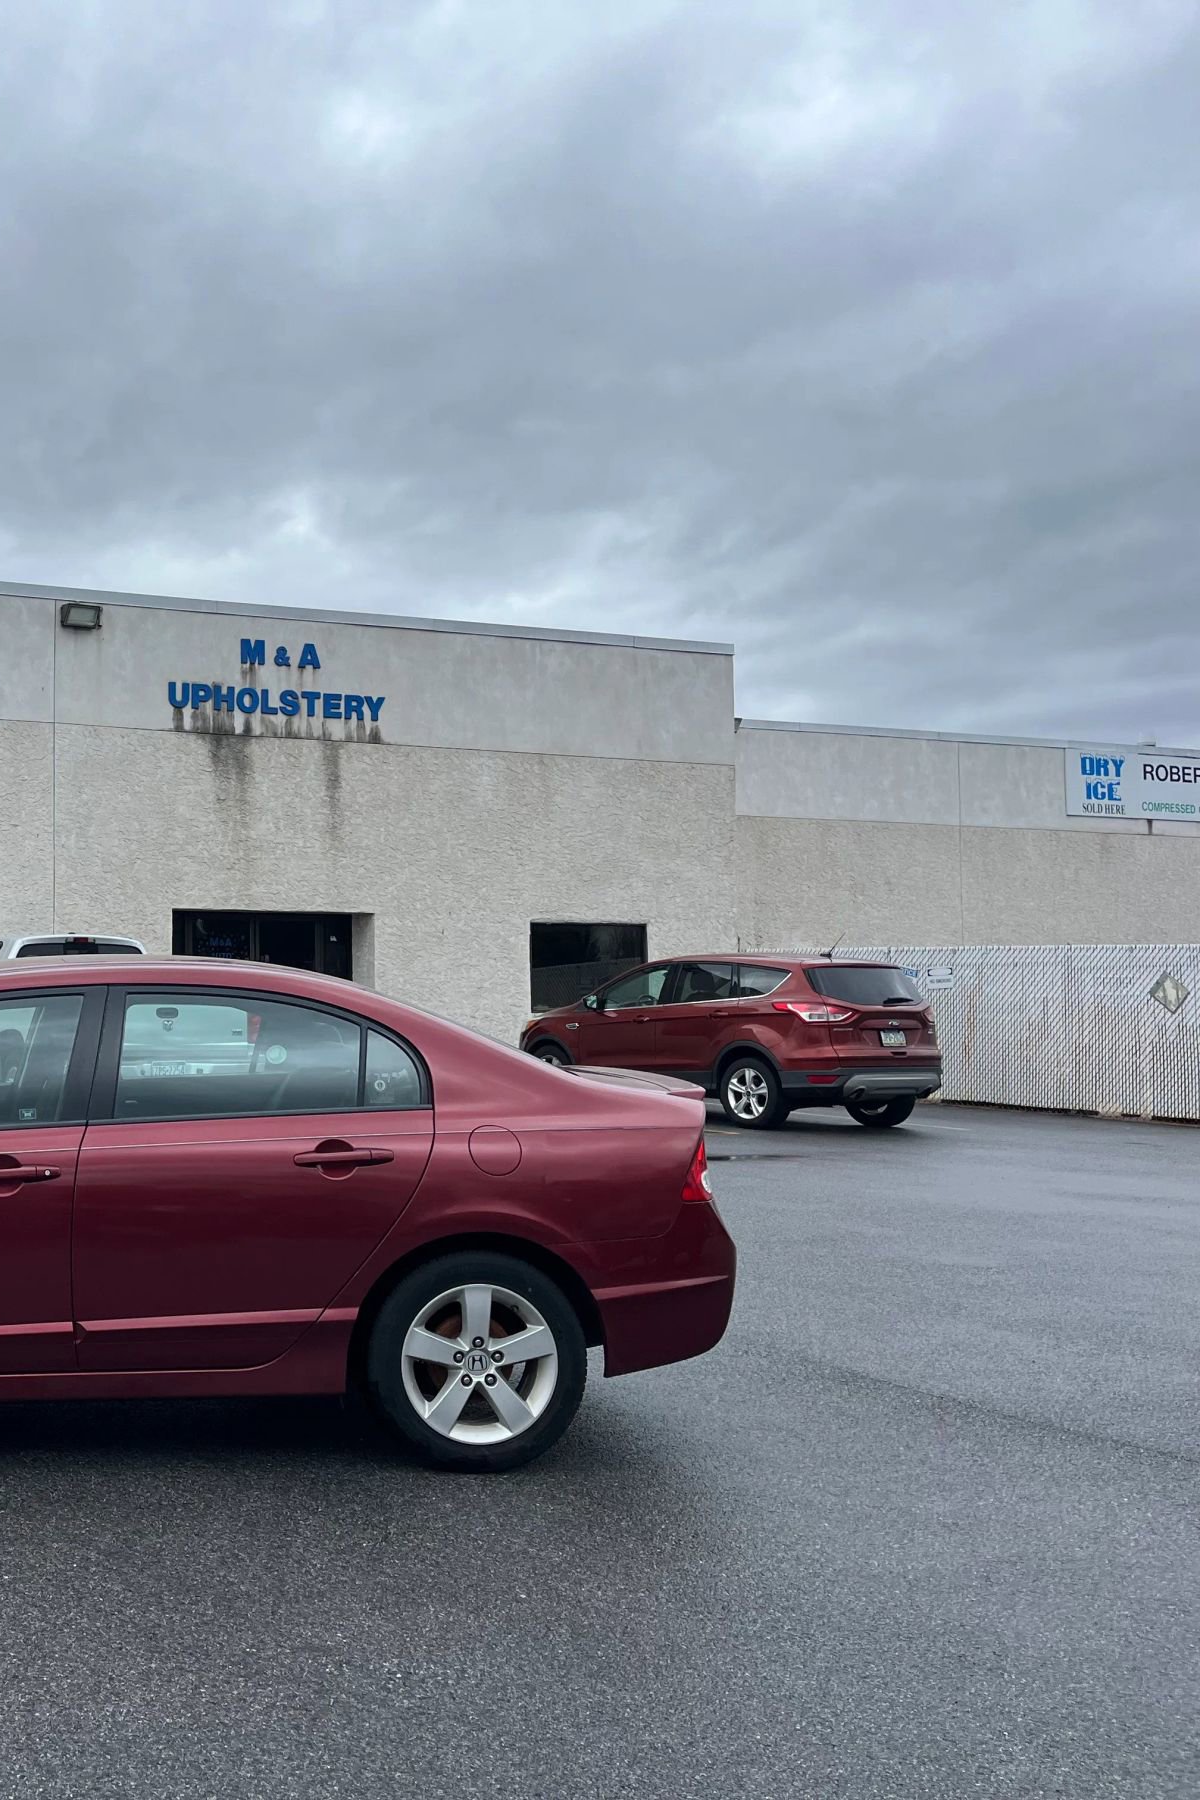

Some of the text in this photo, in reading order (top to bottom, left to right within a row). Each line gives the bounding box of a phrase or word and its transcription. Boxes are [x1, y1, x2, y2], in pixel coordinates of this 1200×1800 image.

[240, 638, 321, 669] M & A
[168, 681, 386, 722] UPHOLSTERY
[1080, 753, 1125, 777] DRY
[1085, 778, 1122, 801] ICE
[1082, 803, 1126, 815] SOLD HERE
[1142, 802, 1196, 814] COMPRESSED
